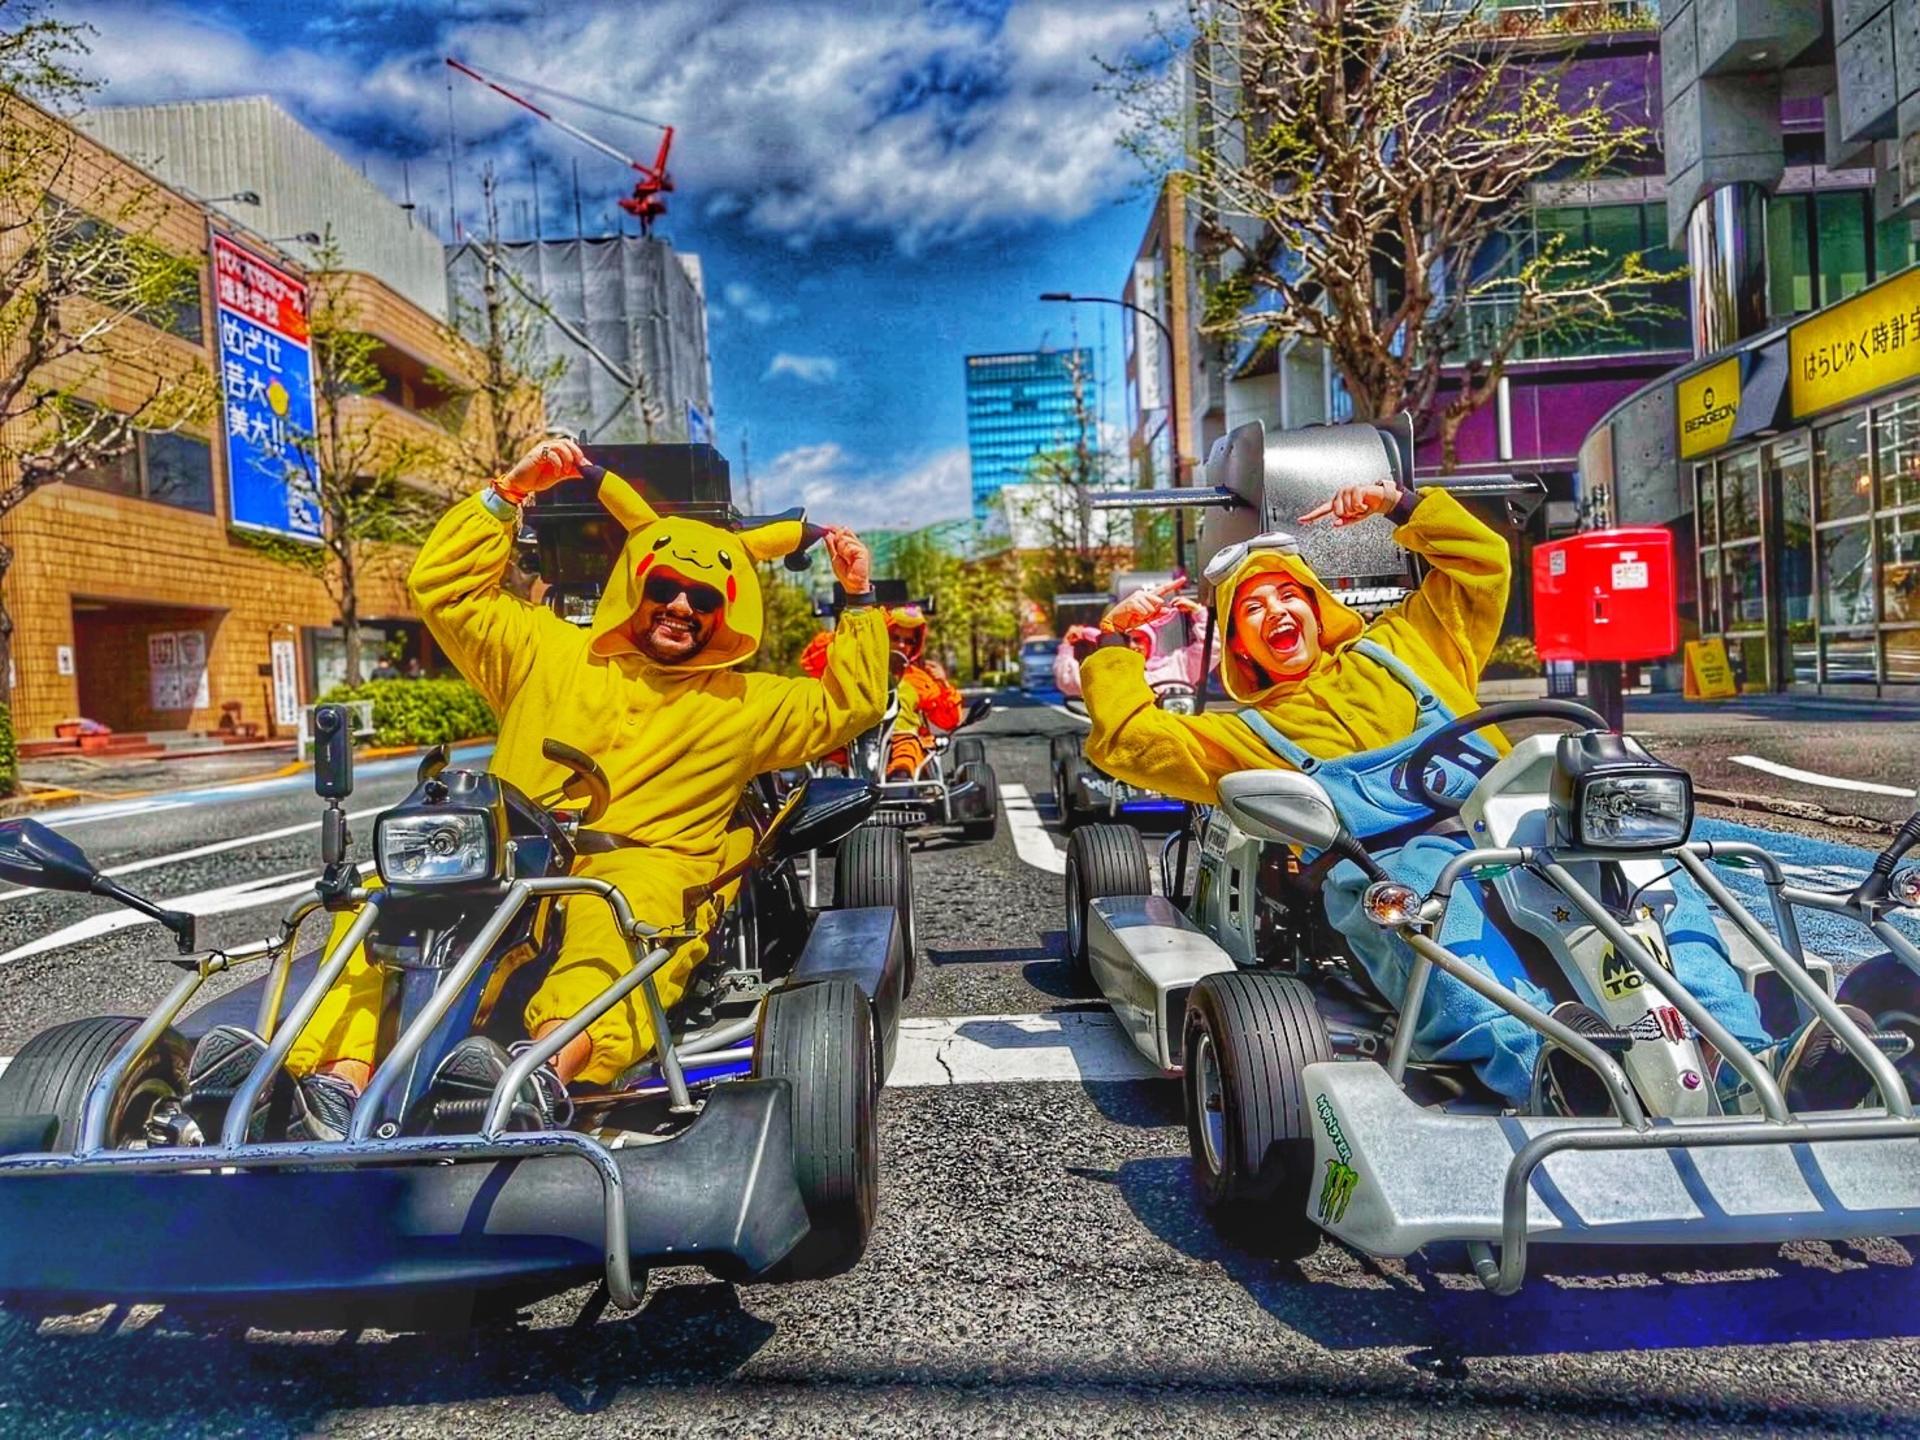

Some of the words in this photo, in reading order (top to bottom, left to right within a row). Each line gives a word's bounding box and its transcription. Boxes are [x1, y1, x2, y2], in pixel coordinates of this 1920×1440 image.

[223, 314, 283, 373] めざせ
[226, 360, 268, 408] 芸大
[1684, 401, 1737, 434] BERGEON
